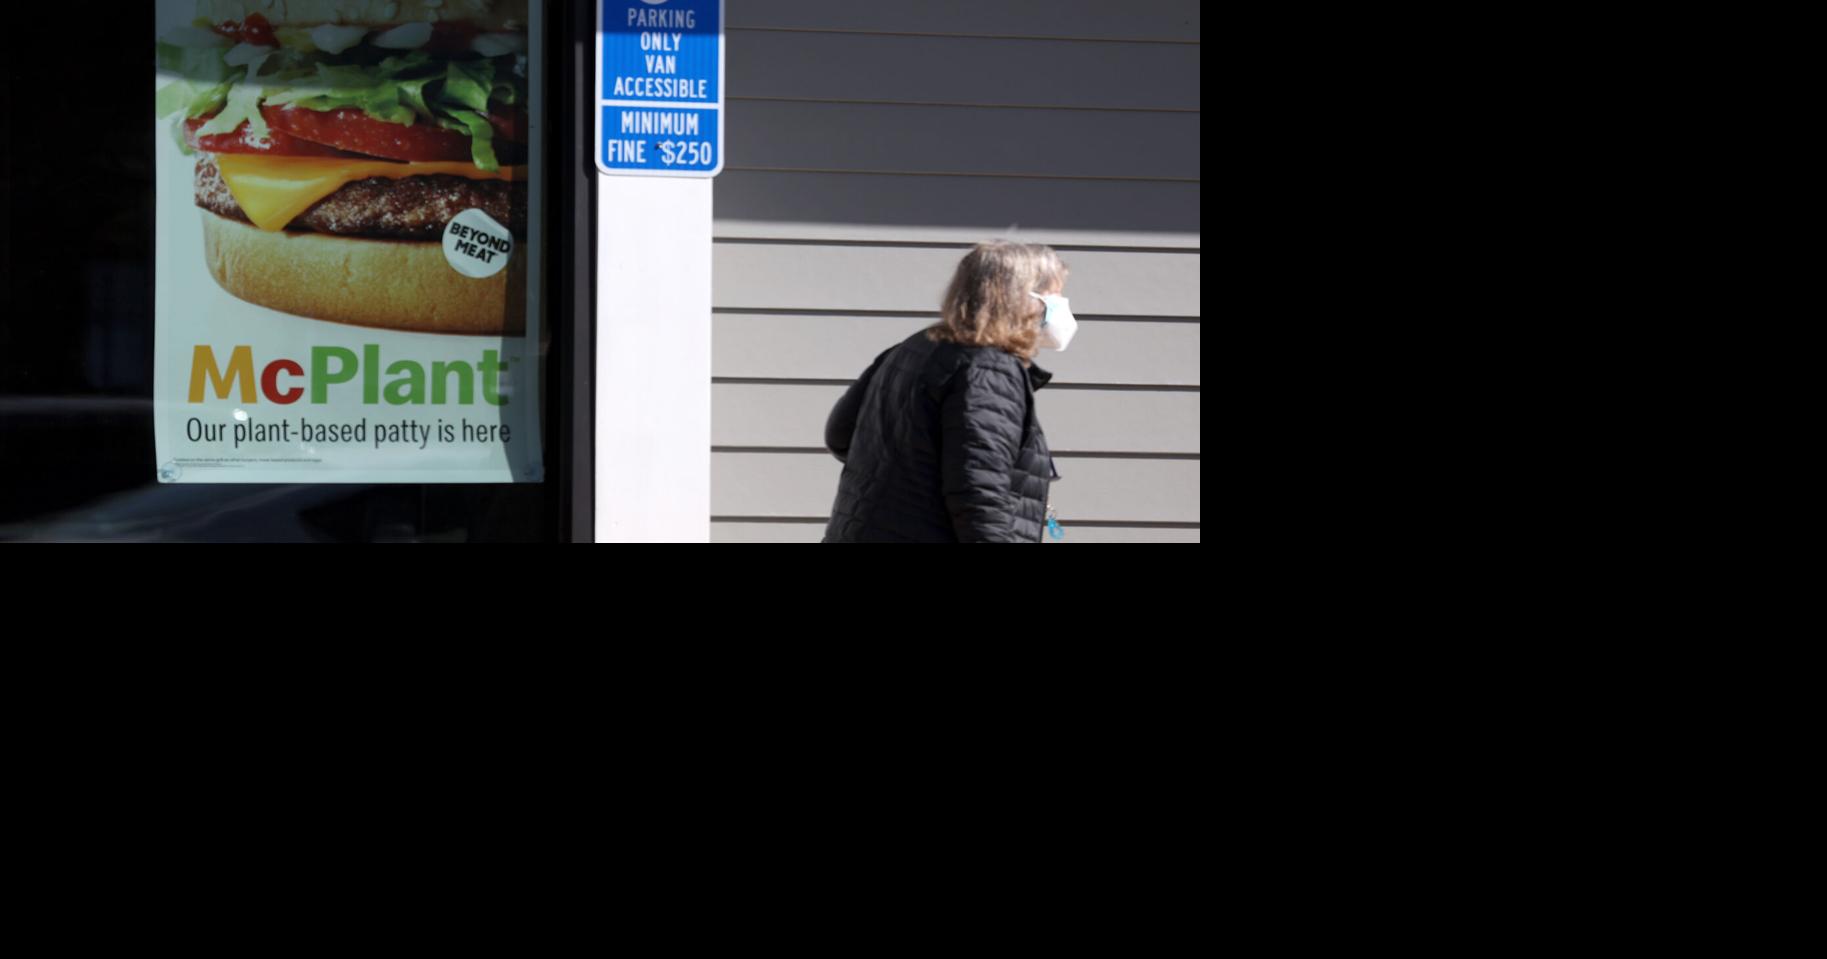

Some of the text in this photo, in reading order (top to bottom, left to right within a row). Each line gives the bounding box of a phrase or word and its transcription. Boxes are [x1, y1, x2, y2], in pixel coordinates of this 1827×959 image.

[627, 8, 696, 29] PARKING
[640, 32, 682, 51] ONLY
[645, 54, 676, 74] VAN
[613, 77, 708, 98] ACCESSIBLE
[621, 111, 699, 136] MINIMUM
[608, 139, 712, 166] FINE $250
[449, 221, 511, 253] BEYOND
[454, 239, 496, 264] MEAT
[187, 344, 509, 406] McPlant
[186, 417, 512, 449] Our plant-based patty is here
